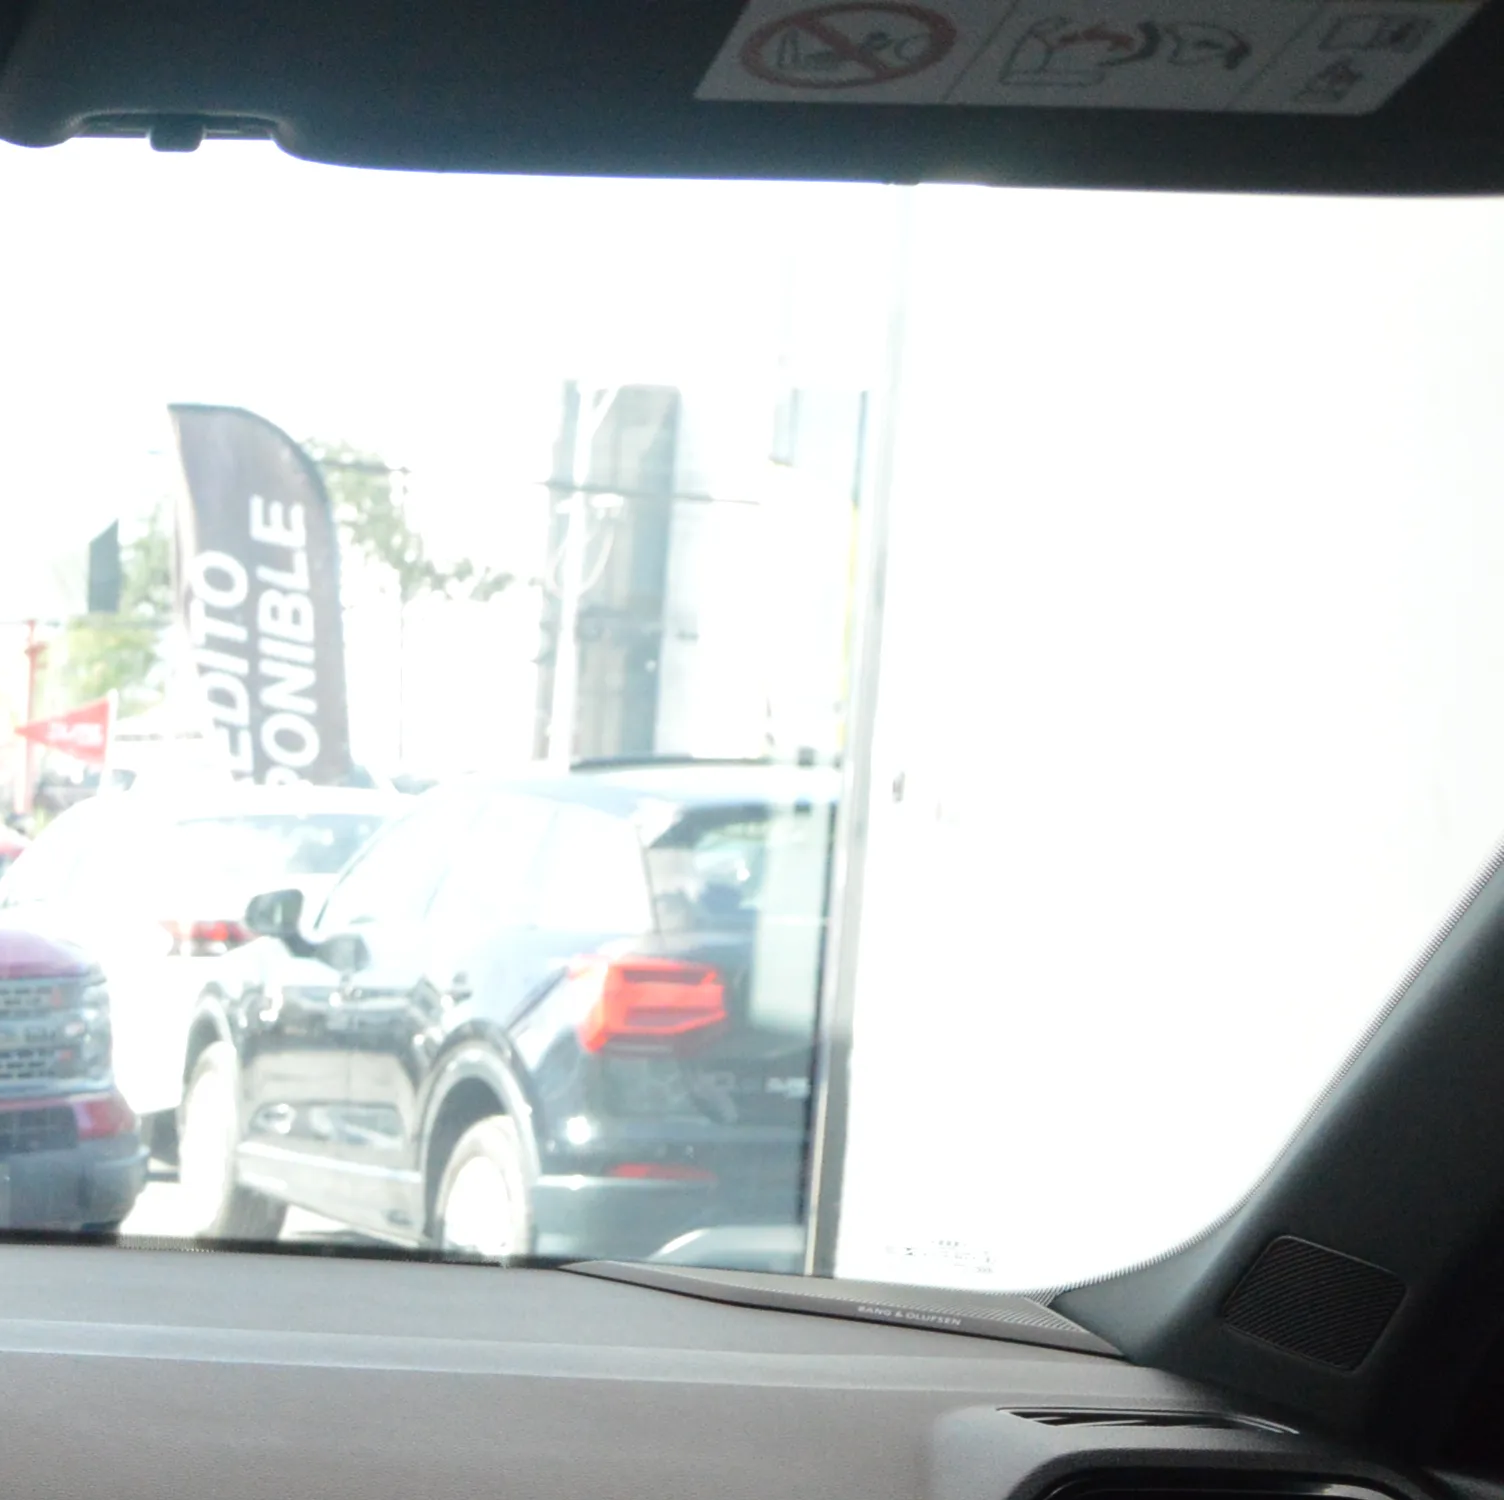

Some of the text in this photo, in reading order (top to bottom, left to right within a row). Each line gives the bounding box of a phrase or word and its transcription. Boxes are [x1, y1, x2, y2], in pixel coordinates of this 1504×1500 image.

[857, 1305, 962, 1326] BANG & OLUFSEN
